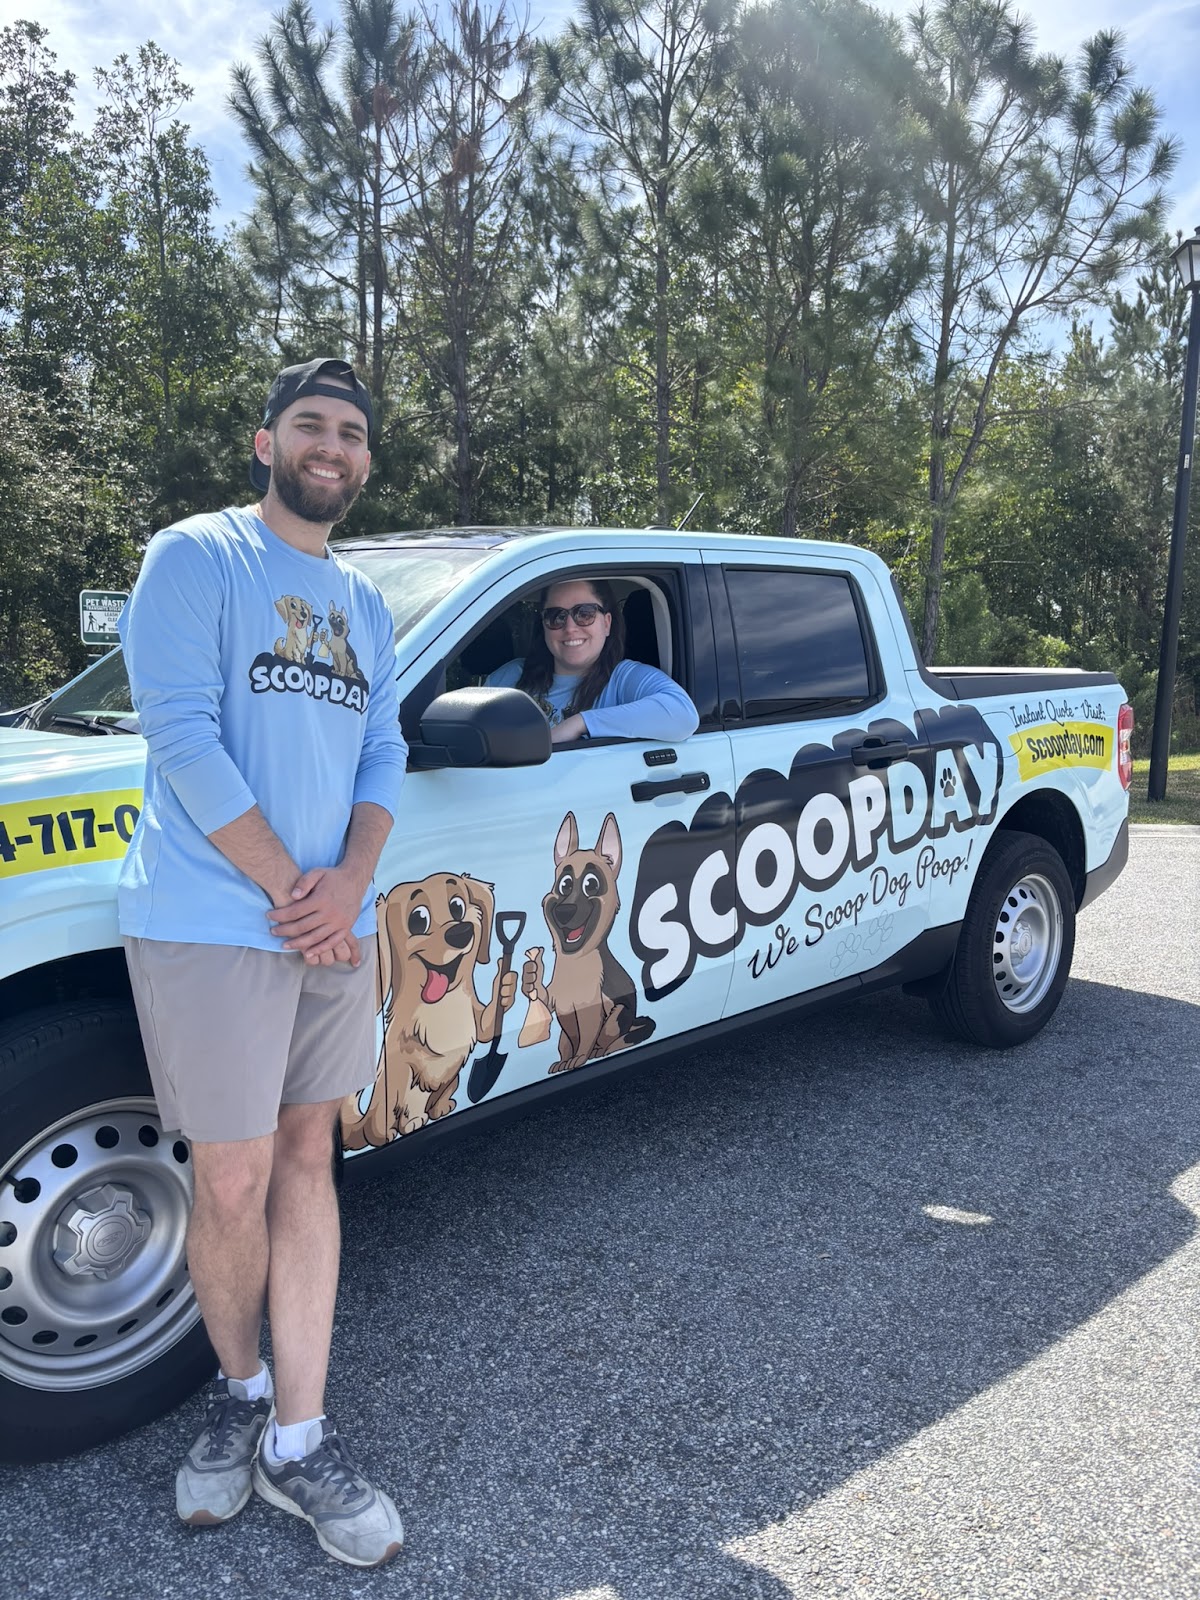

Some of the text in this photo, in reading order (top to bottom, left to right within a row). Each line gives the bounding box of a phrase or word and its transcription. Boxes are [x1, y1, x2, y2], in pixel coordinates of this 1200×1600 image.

[101, 599, 125, 607] WASTE
[1009, 701, 1046, 728] Instant
[1045, 699, 1074, 727] Quote
[1080, 699, 1107, 721] Visit:
[1026, 729, 1105, 763] Scoopday.com
[637, 742, 998, 990] SCOOPDAY
[747, 838, 974, 979] We Scoop Dog Poop!
